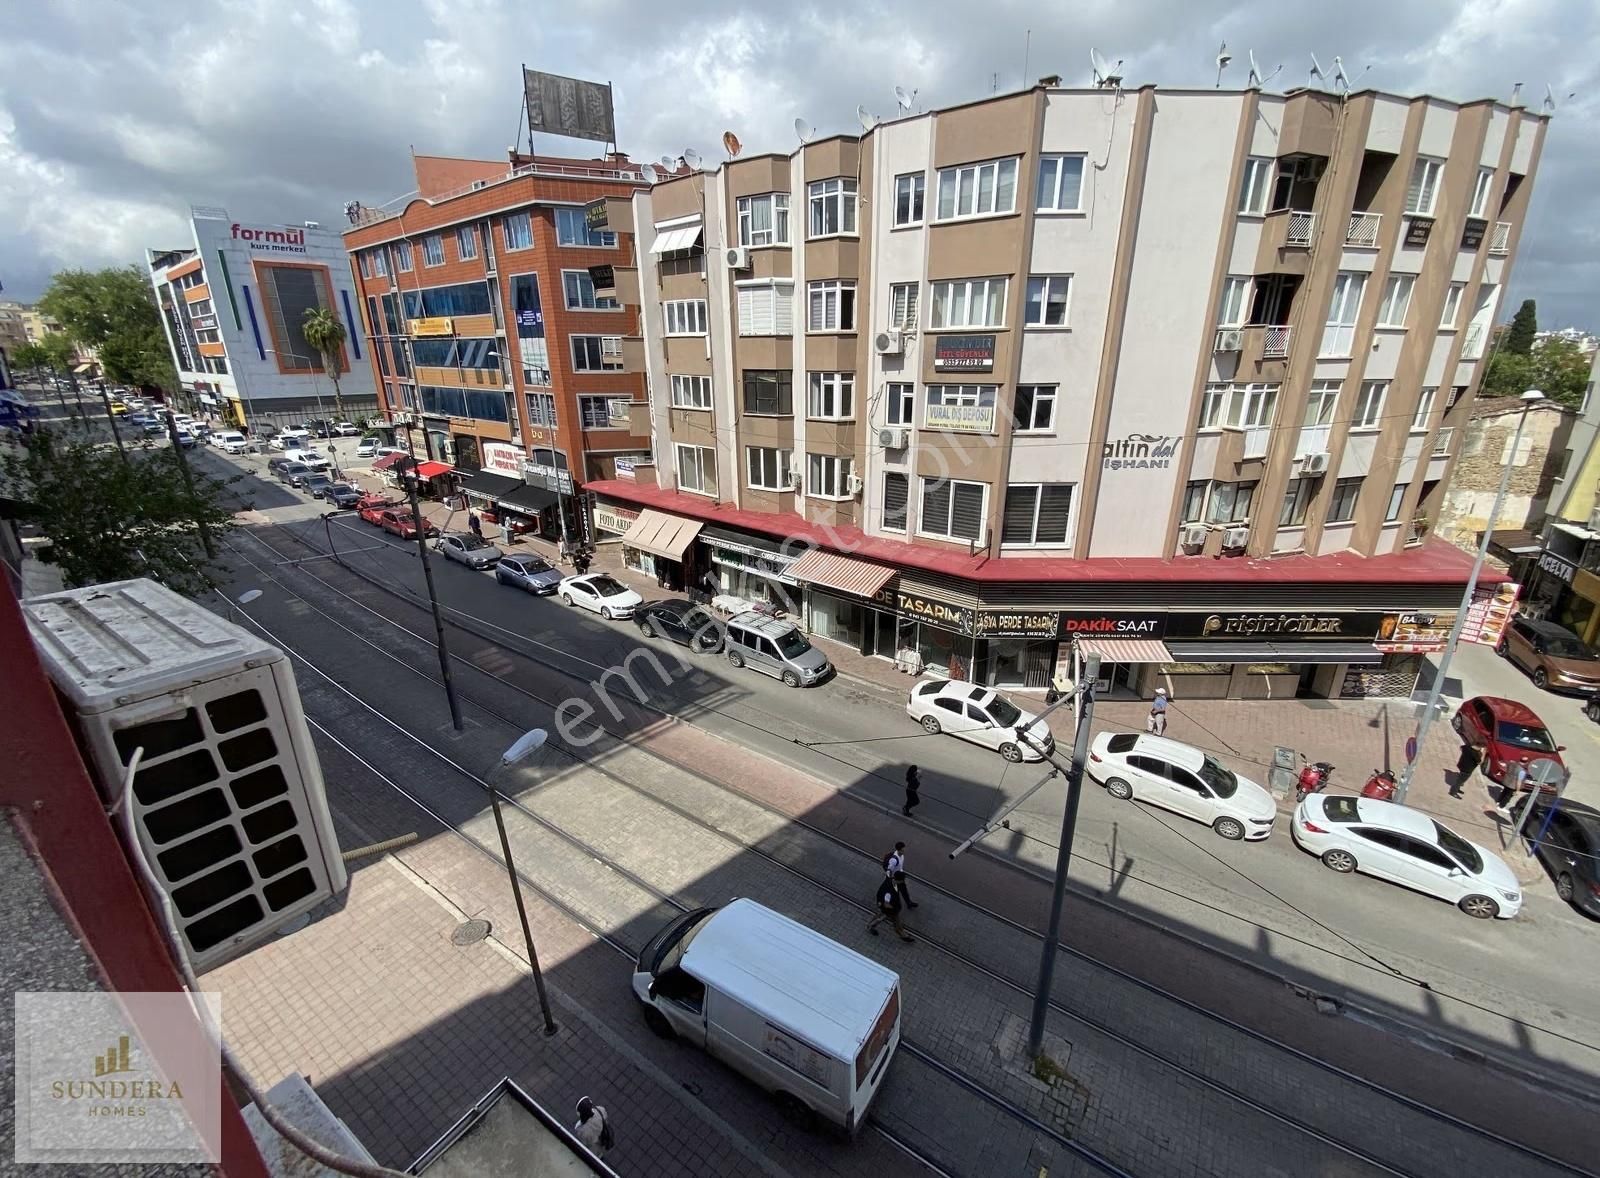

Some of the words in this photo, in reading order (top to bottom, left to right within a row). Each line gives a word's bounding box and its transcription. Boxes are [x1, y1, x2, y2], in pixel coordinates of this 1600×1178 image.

[251, 242, 270, 250] kurs
[272, 244, 306, 253] merkezi
[929, 406, 950, 419] VURAL
[963, 408, 990, 422] DEPOSU
[599, 513, 615, 527] FOTO
[897, 594, 960, 623] TASARIM
[999, 615, 1022, 629] PERDE
